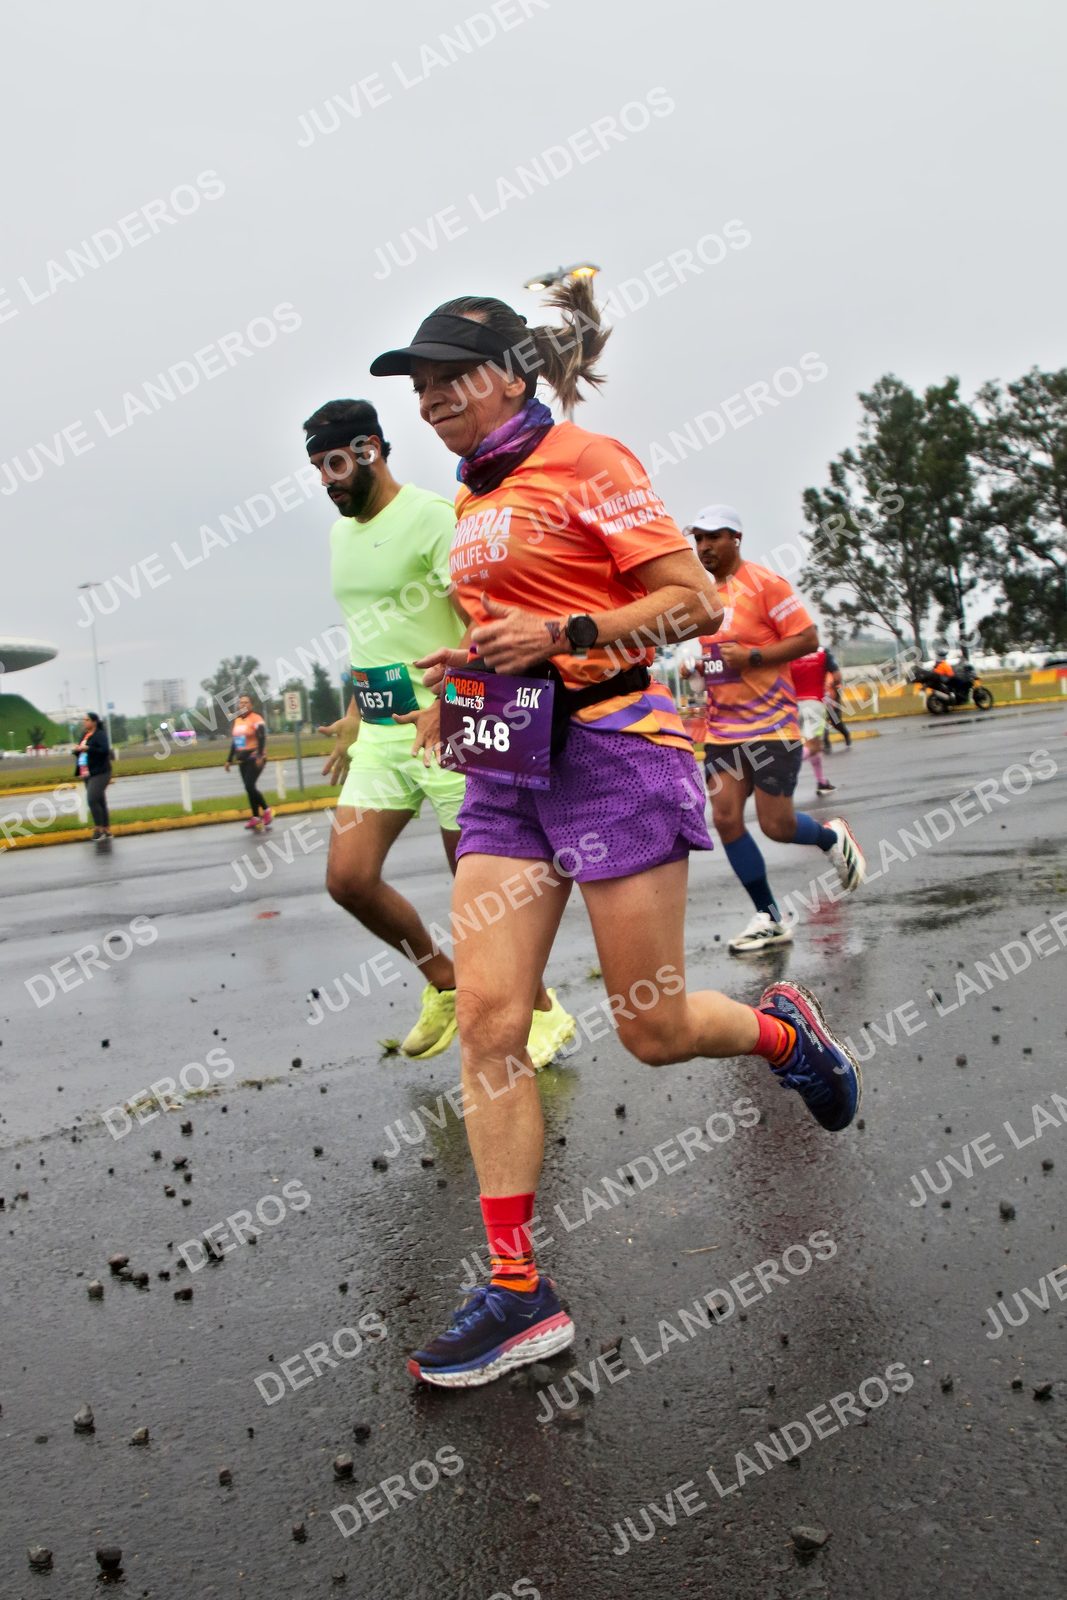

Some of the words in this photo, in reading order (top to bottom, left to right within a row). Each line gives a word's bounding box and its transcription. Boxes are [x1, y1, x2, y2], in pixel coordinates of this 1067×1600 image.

[385, 668, 402, 682] 10K
[360, 691, 393, 709] 1637
[516, 686, 542, 709] 15K
[462, 716, 510, 752] 348
